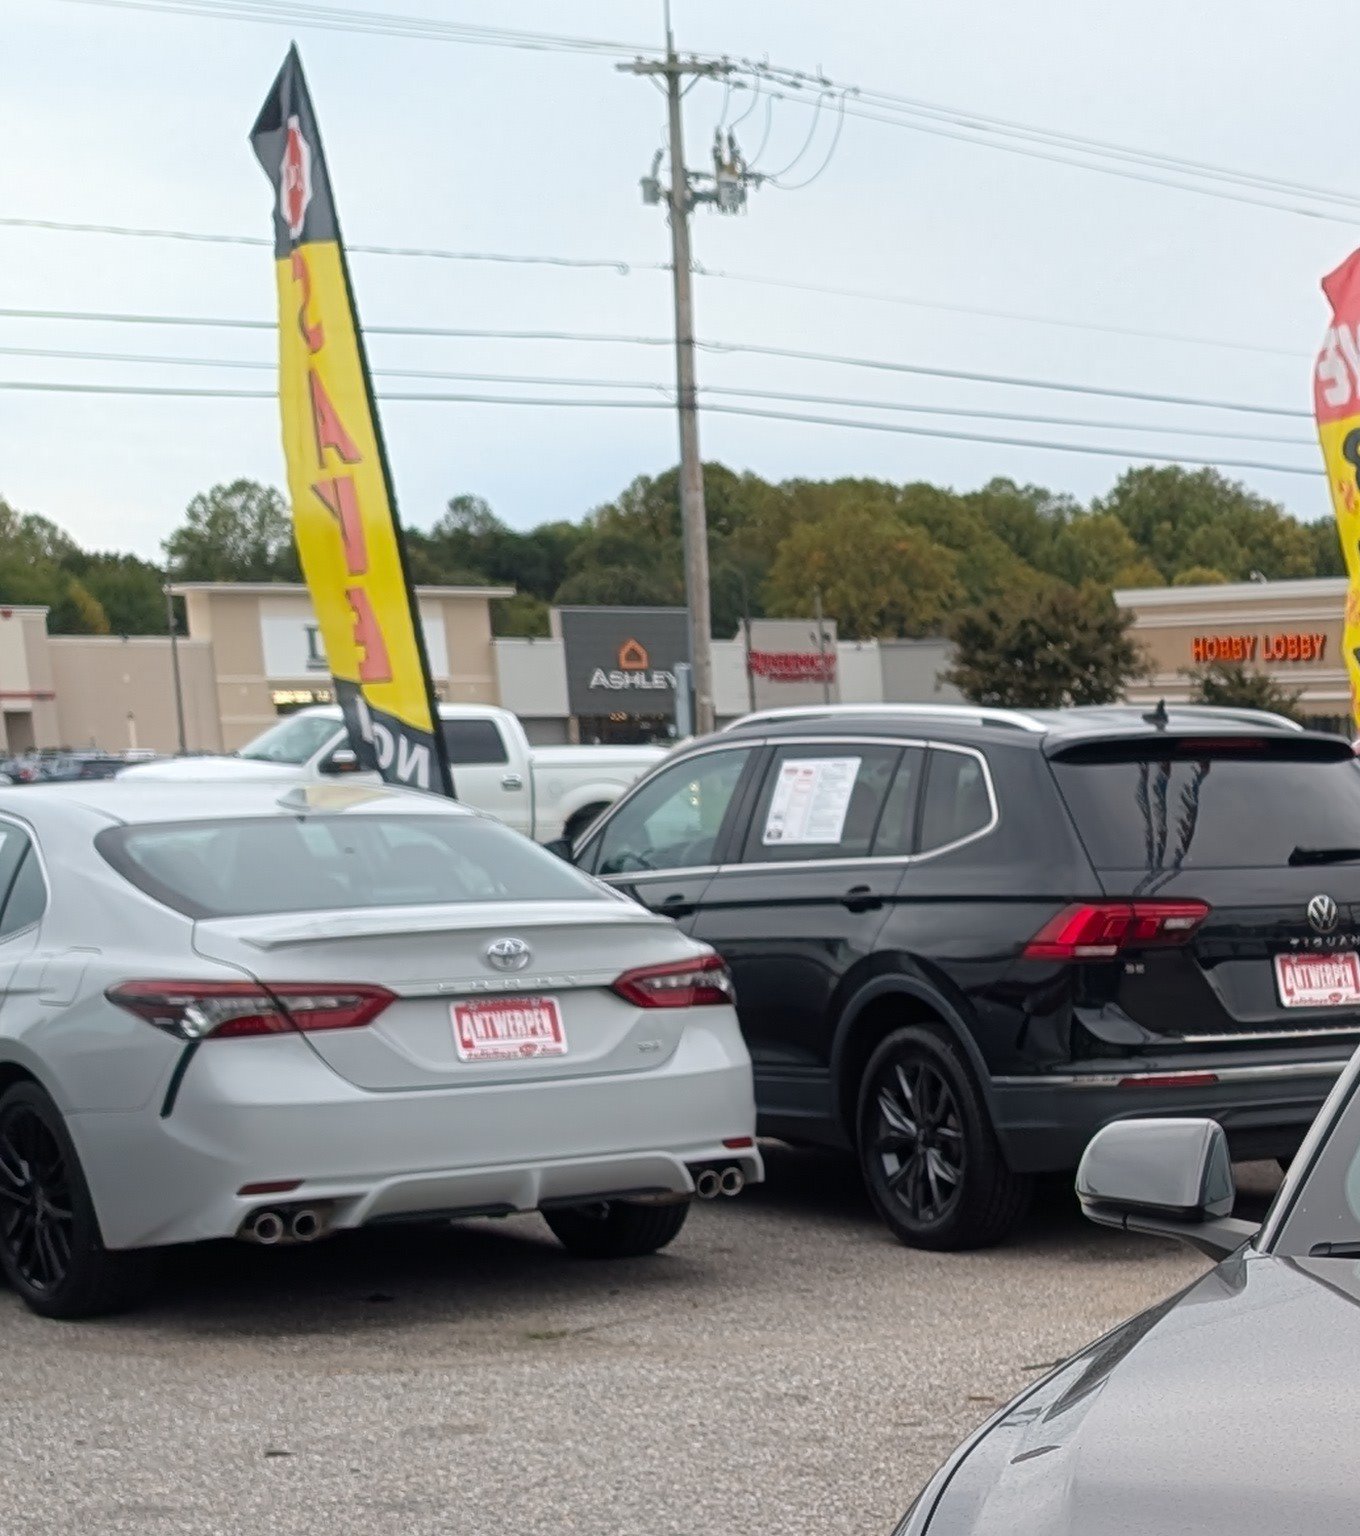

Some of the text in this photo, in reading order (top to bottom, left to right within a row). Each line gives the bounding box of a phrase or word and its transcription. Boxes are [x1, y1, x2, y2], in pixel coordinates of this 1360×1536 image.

[1192, 633, 1328, 663] HOBBY LOBBY
[589, 667, 678, 690] ASHLEY
[461, 1008, 552, 1046] ANTWERPEN
